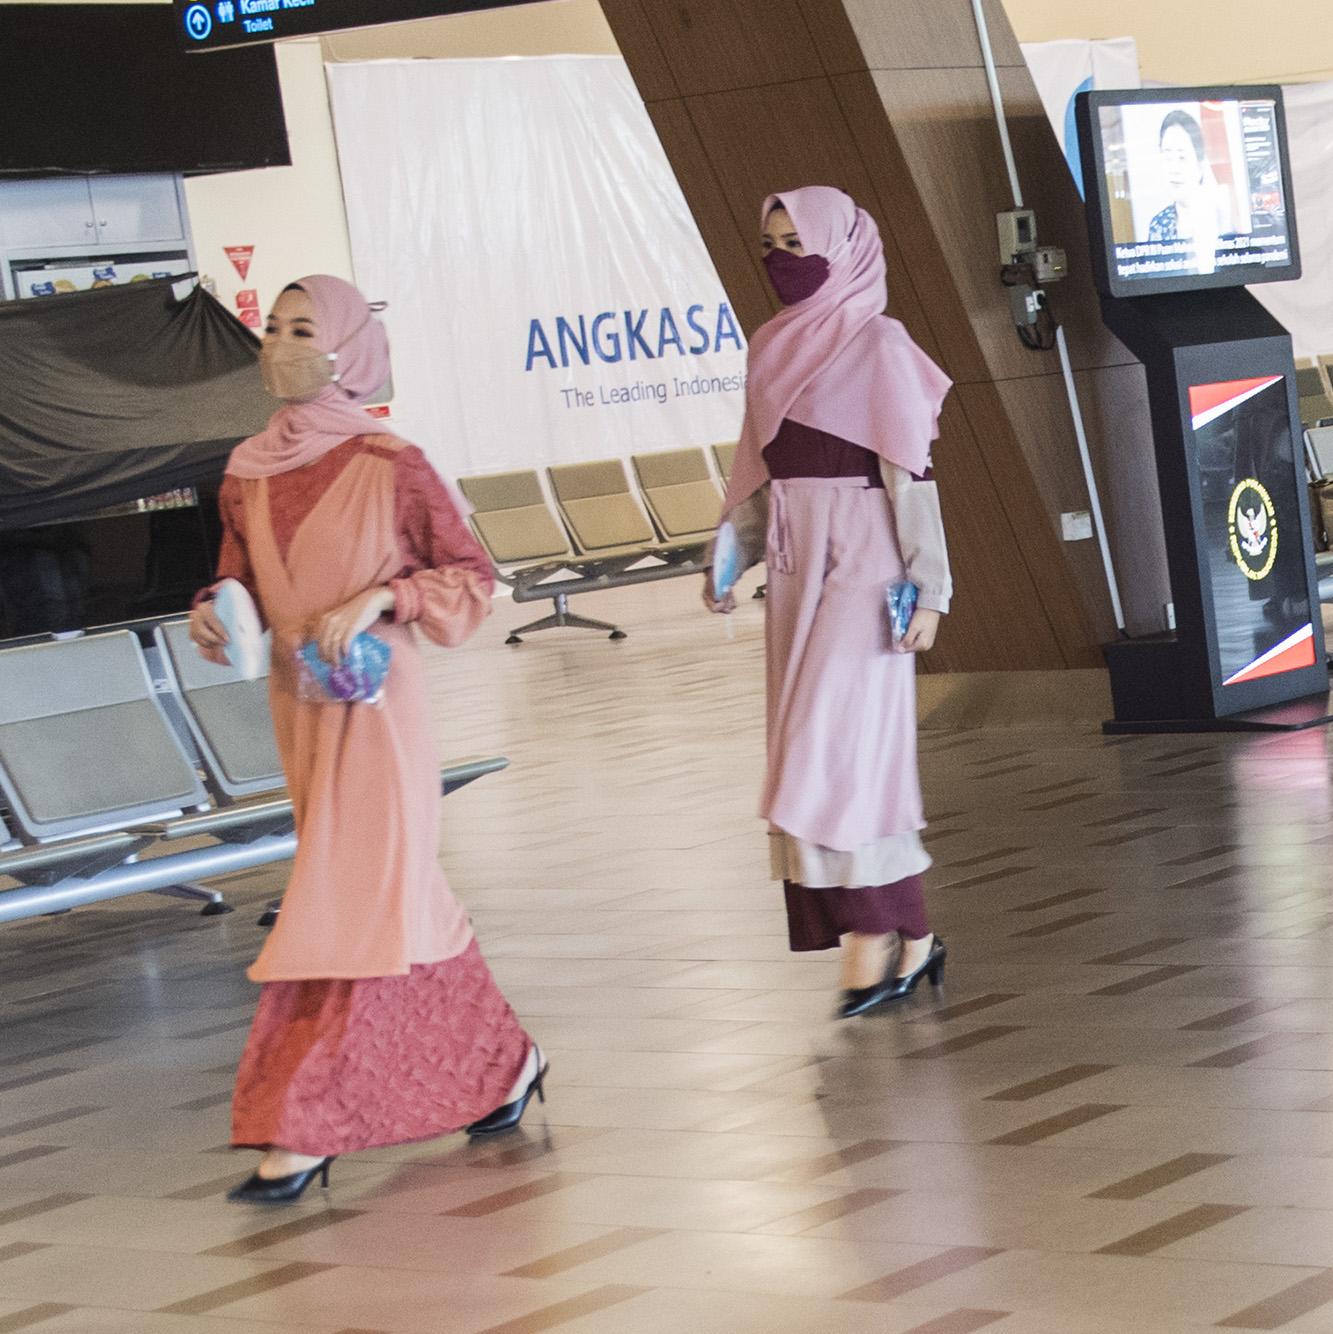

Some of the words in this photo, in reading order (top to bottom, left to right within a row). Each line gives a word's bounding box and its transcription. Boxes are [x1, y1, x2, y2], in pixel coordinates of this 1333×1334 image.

[240, 0, 280, 15] Kamar
[282, 0, 315, 9] Kec
[243, 17, 274, 33] Toilet
[525, 302, 744, 372] ANGKASA
[560, 388, 595, 408] The
[600, 380, 667, 404] Leading
